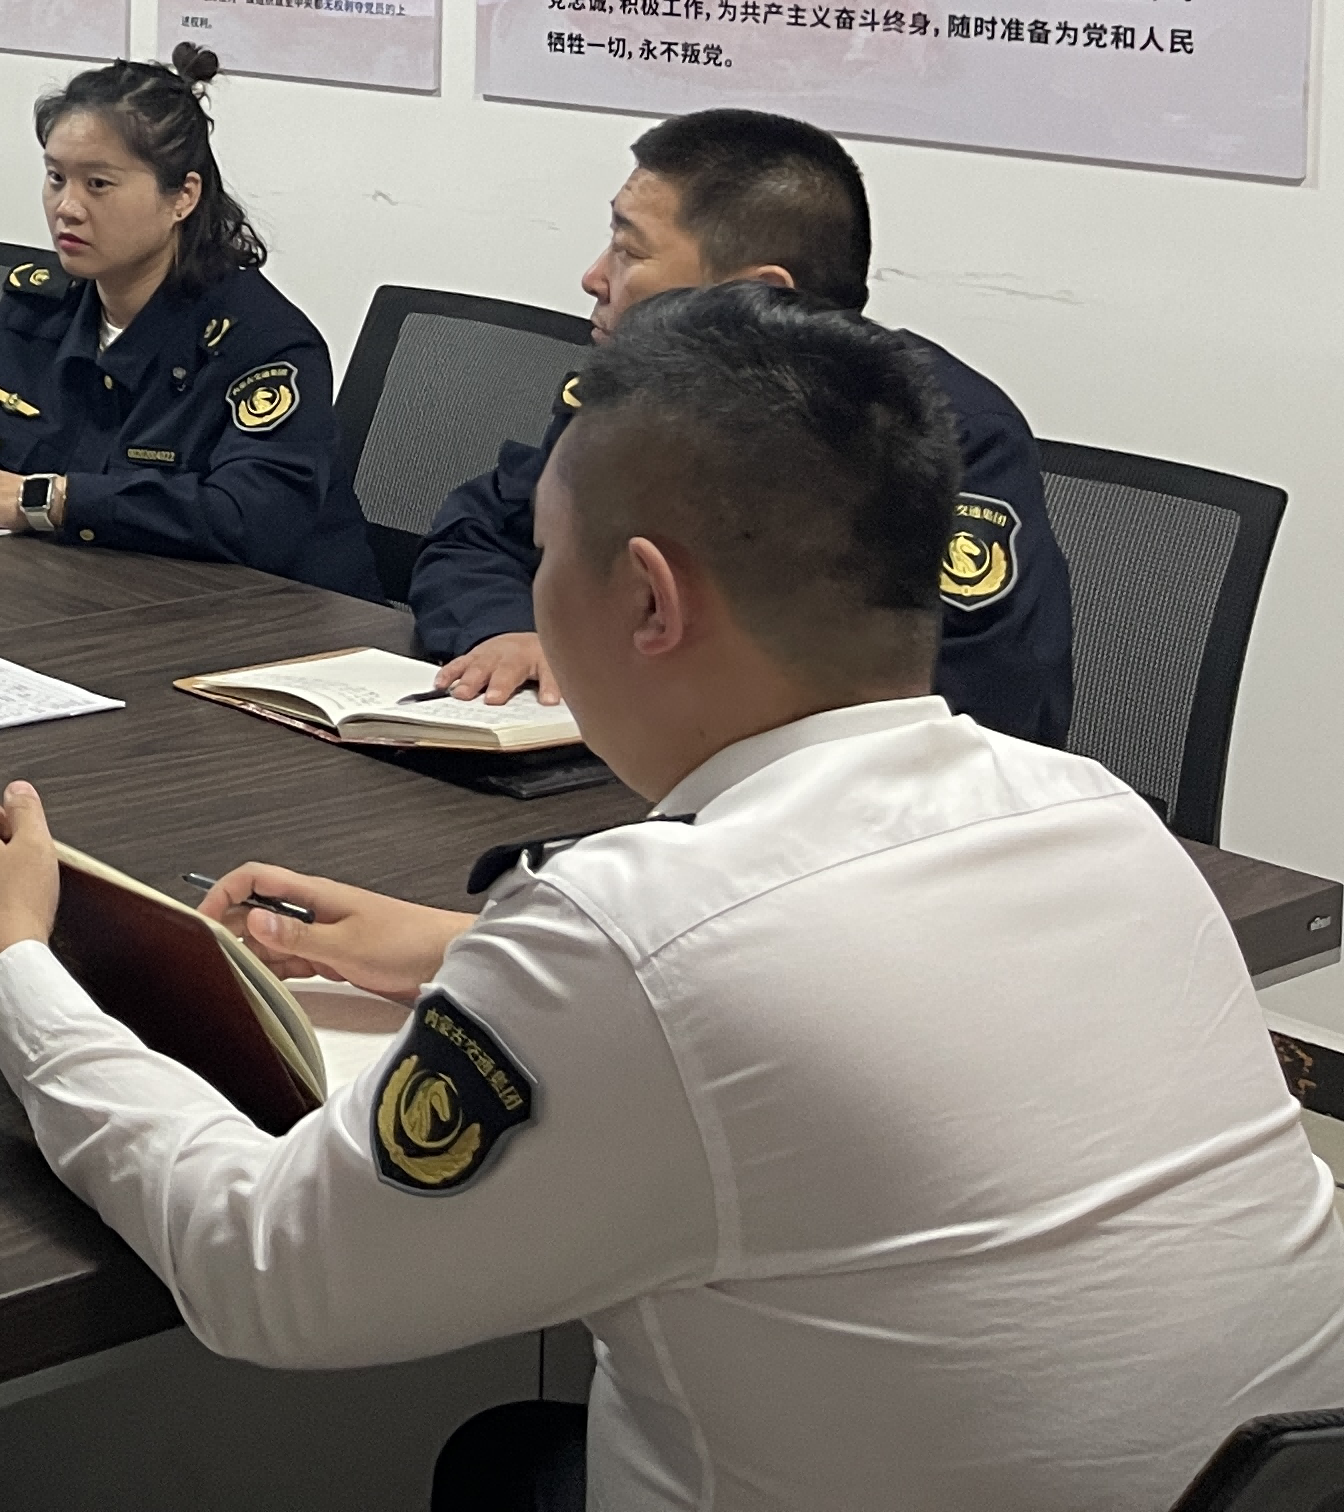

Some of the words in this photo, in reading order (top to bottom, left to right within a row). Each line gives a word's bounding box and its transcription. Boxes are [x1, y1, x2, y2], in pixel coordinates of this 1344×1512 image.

[547, 31, 733, 67] 牺牲一切，永不叛党。
